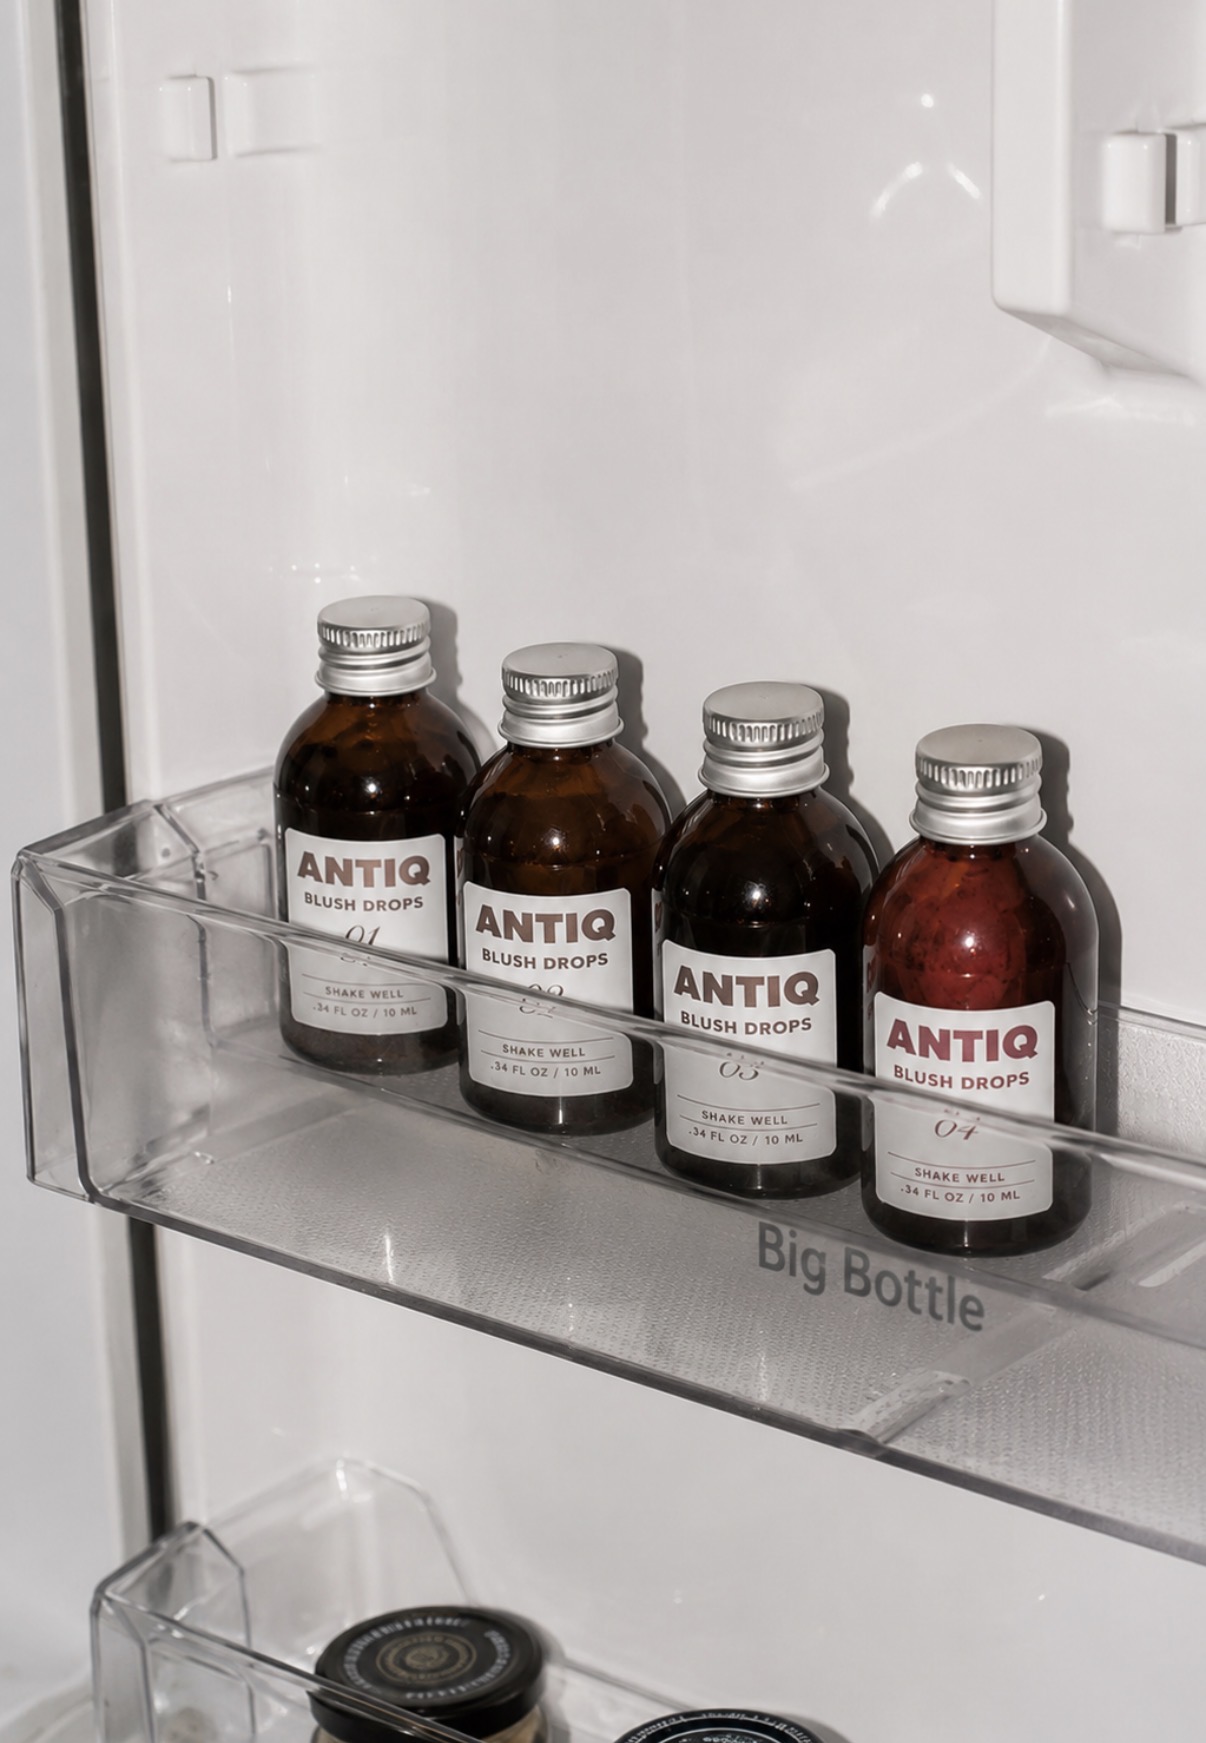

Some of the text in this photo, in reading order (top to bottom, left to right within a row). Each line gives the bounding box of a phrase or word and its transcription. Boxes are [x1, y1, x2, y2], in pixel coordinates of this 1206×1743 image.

[297, 851, 430, 888] ANTIQ
[305, 892, 423, 911] BLUSH DROPS
[476, 904, 616, 943] ANTIQ
[483, 948, 608, 969] BLUSH DROPS
[325, 986, 403, 999] SHAKE WELL
[674, 965, 819, 1008] ANTIQ
[313, 1003, 329, 1012] .34
[334, 1006, 347, 1016] FL
[352, 1008, 368, 1017] OZ
[384, 1007, 395, 1017] 10
[401, 1006, 417, 1016] ML
[681, 1011, 812, 1035] BLUSH DROPS
[887, 1018, 1038, 1062] ANTIQ
[503, 1044, 585, 1057] SHAKE WELL
[491, 1062, 507, 1072] .34
[513, 1066, 525, 1076] FL
[531, 1067, 548, 1077] OZ
[565, 1068, 578, 1077] 10
[584, 1066, 601, 1075] ML
[894, 1065, 1029, 1089] BLUSH DROPS
[702, 1110, 788, 1125] SHAKE WELL
[689, 1128, 706, 1138] .34
[711, 1132, 724, 1142] FL
[730, 1135, 747, 1144] OZ
[765, 1135, 779, 1144] 10
[785, 1133, 803, 1143] ML
[934, 1119, 979, 1140] 04
[915, 1168, 1005, 1183] SHAKE WELL
[901, 1185, 919, 1195] .34
[925, 1190, 938, 1200] FL
[945, 1192, 963, 1203] OZ
[981, 1193, 995, 1203] 10
[1001, 1191, 1020, 1201] ML
[758, 1221, 985, 1332] Big Bottle
